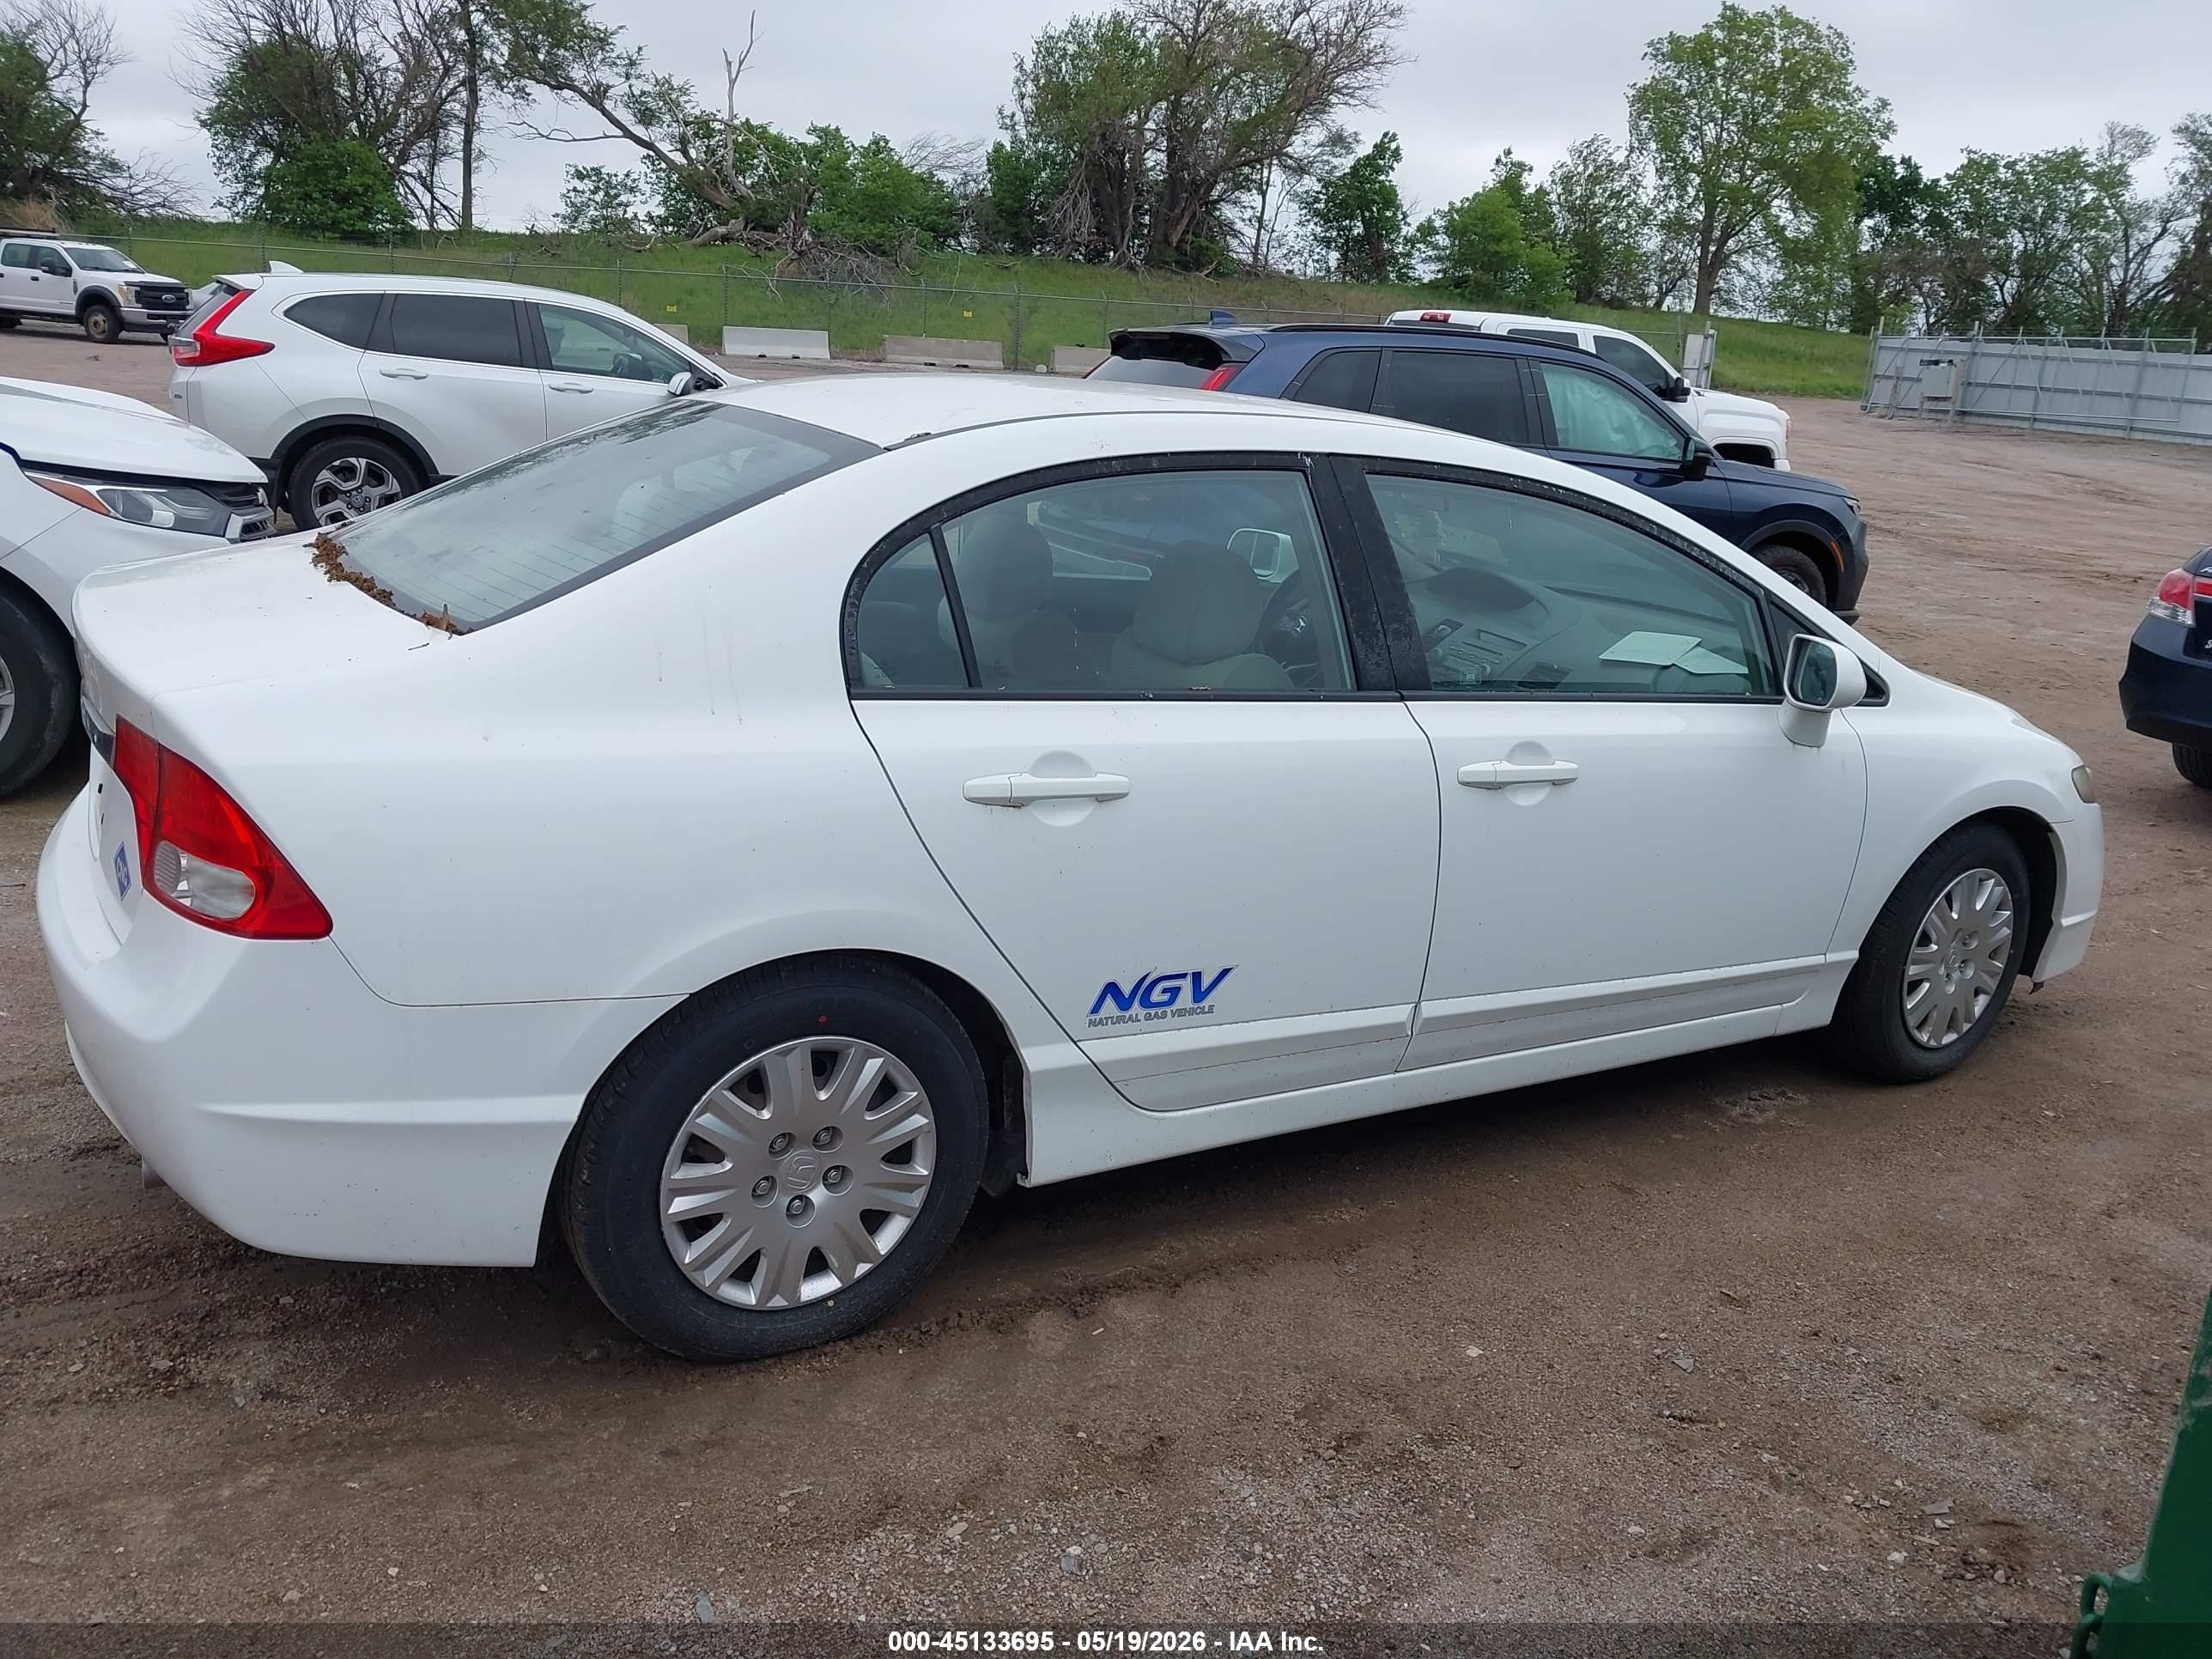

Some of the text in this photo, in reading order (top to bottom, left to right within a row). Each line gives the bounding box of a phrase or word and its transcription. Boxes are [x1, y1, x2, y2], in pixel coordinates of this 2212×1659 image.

[1087, 966, 1237, 1016] NGV
[1087, 1004, 1216, 1028] NATURAL GAS VEHICLE
